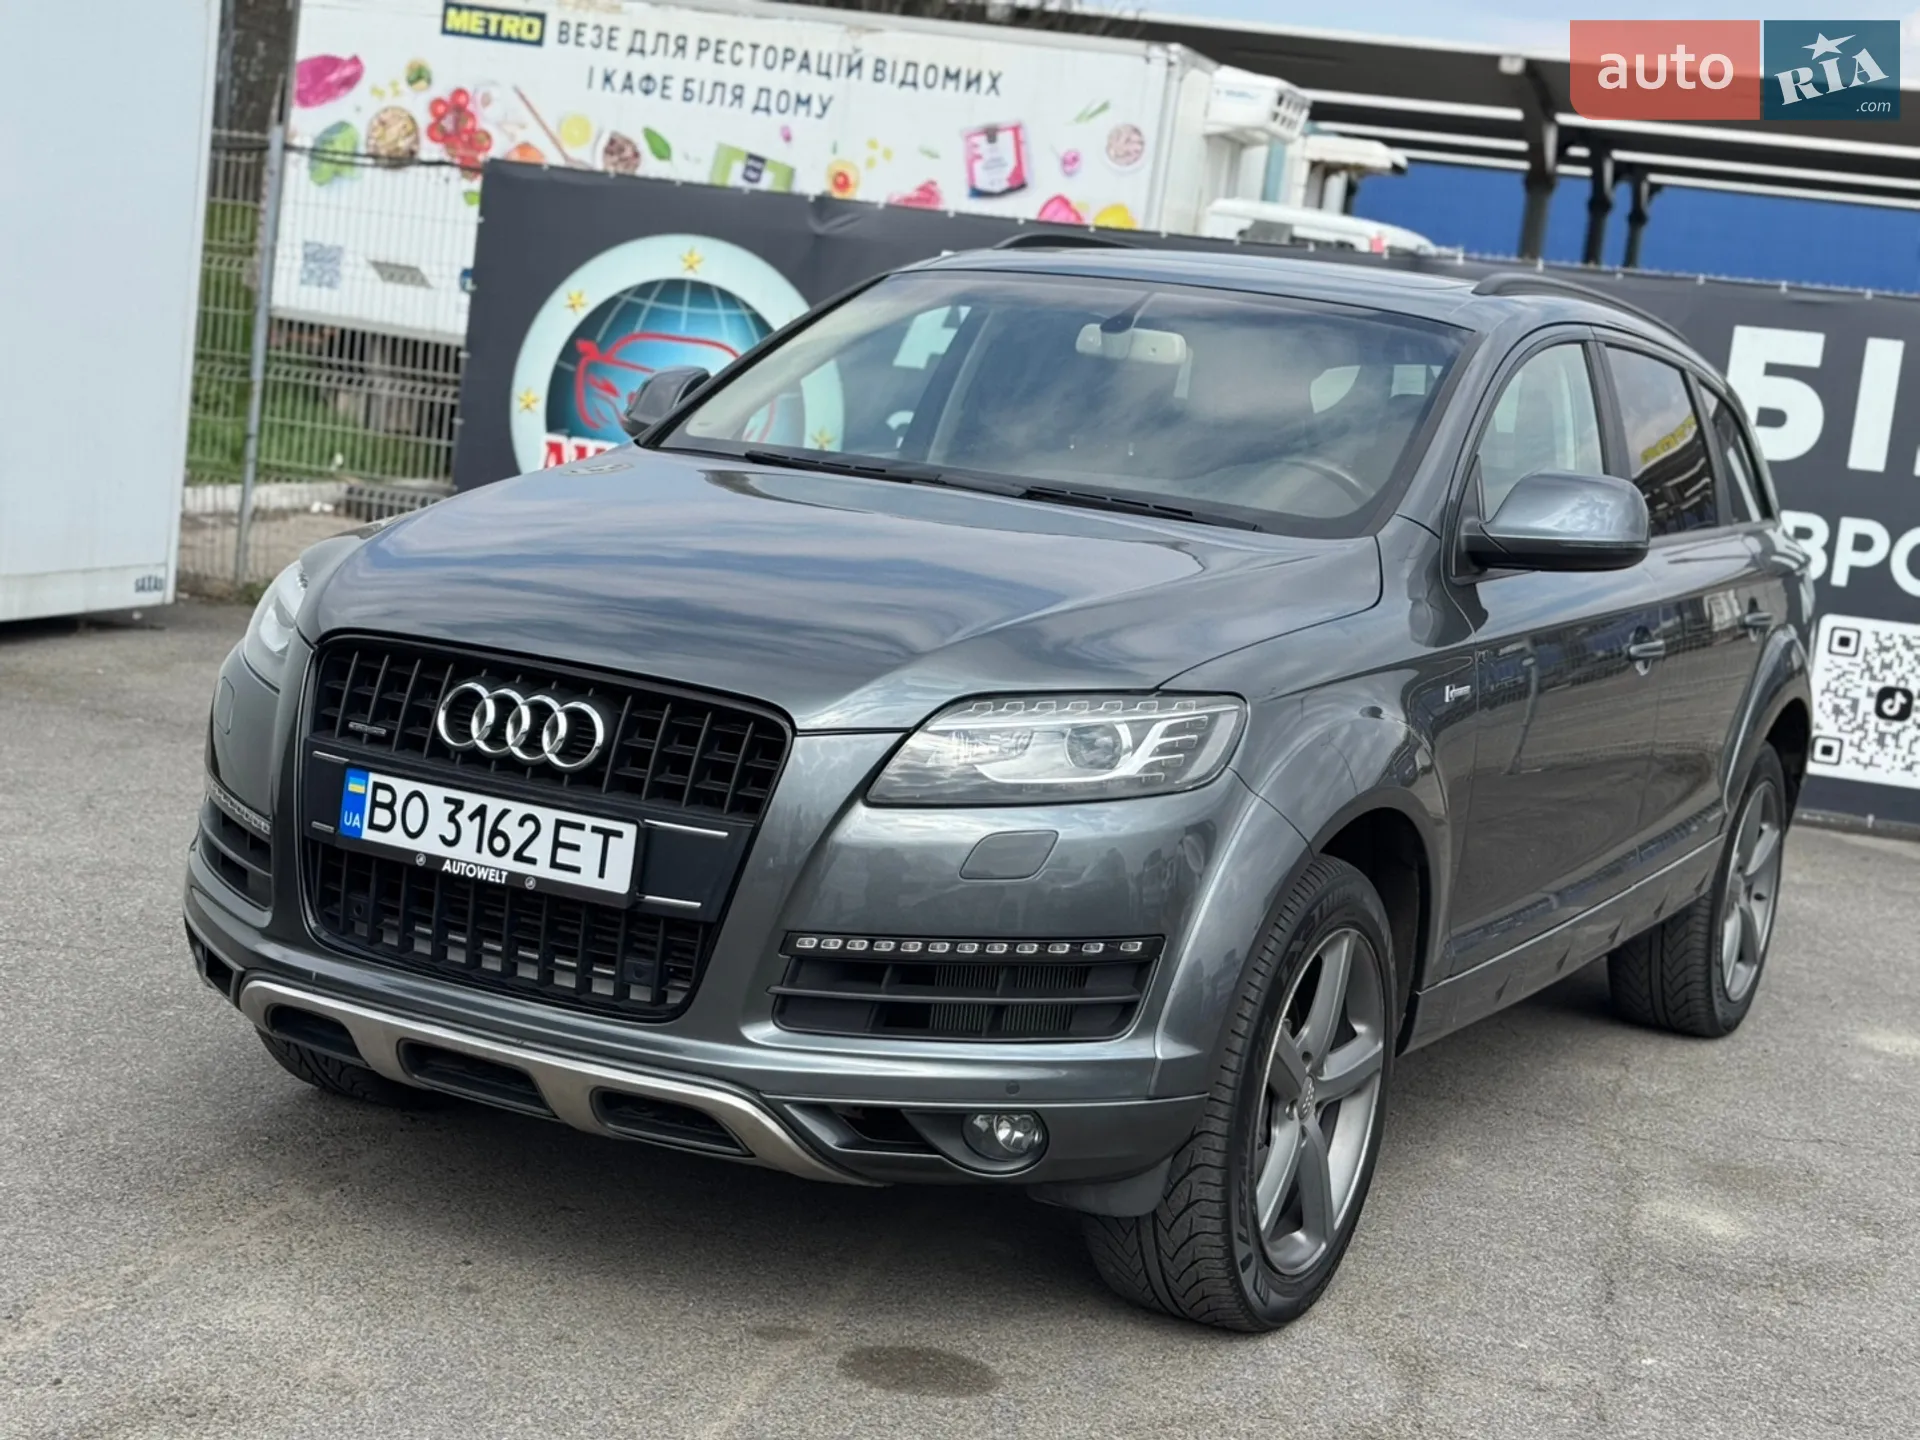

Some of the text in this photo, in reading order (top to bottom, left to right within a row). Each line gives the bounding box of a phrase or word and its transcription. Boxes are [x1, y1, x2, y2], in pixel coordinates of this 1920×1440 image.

[445, 7, 1003, 97] METRO ВЕЗЕ ДЛЯ РЕСТОРАЦІЙ ВІДОМИХ
[587, 65, 834, 120] І КАФЕ БІЛЯ ДОМУ
[1726, 324, 1920, 477] БІ
[343, 810, 361, 828] UA
[367, 780, 624, 879] BO 3162 ET
[441, 858, 508, 885] AUTOWELT
